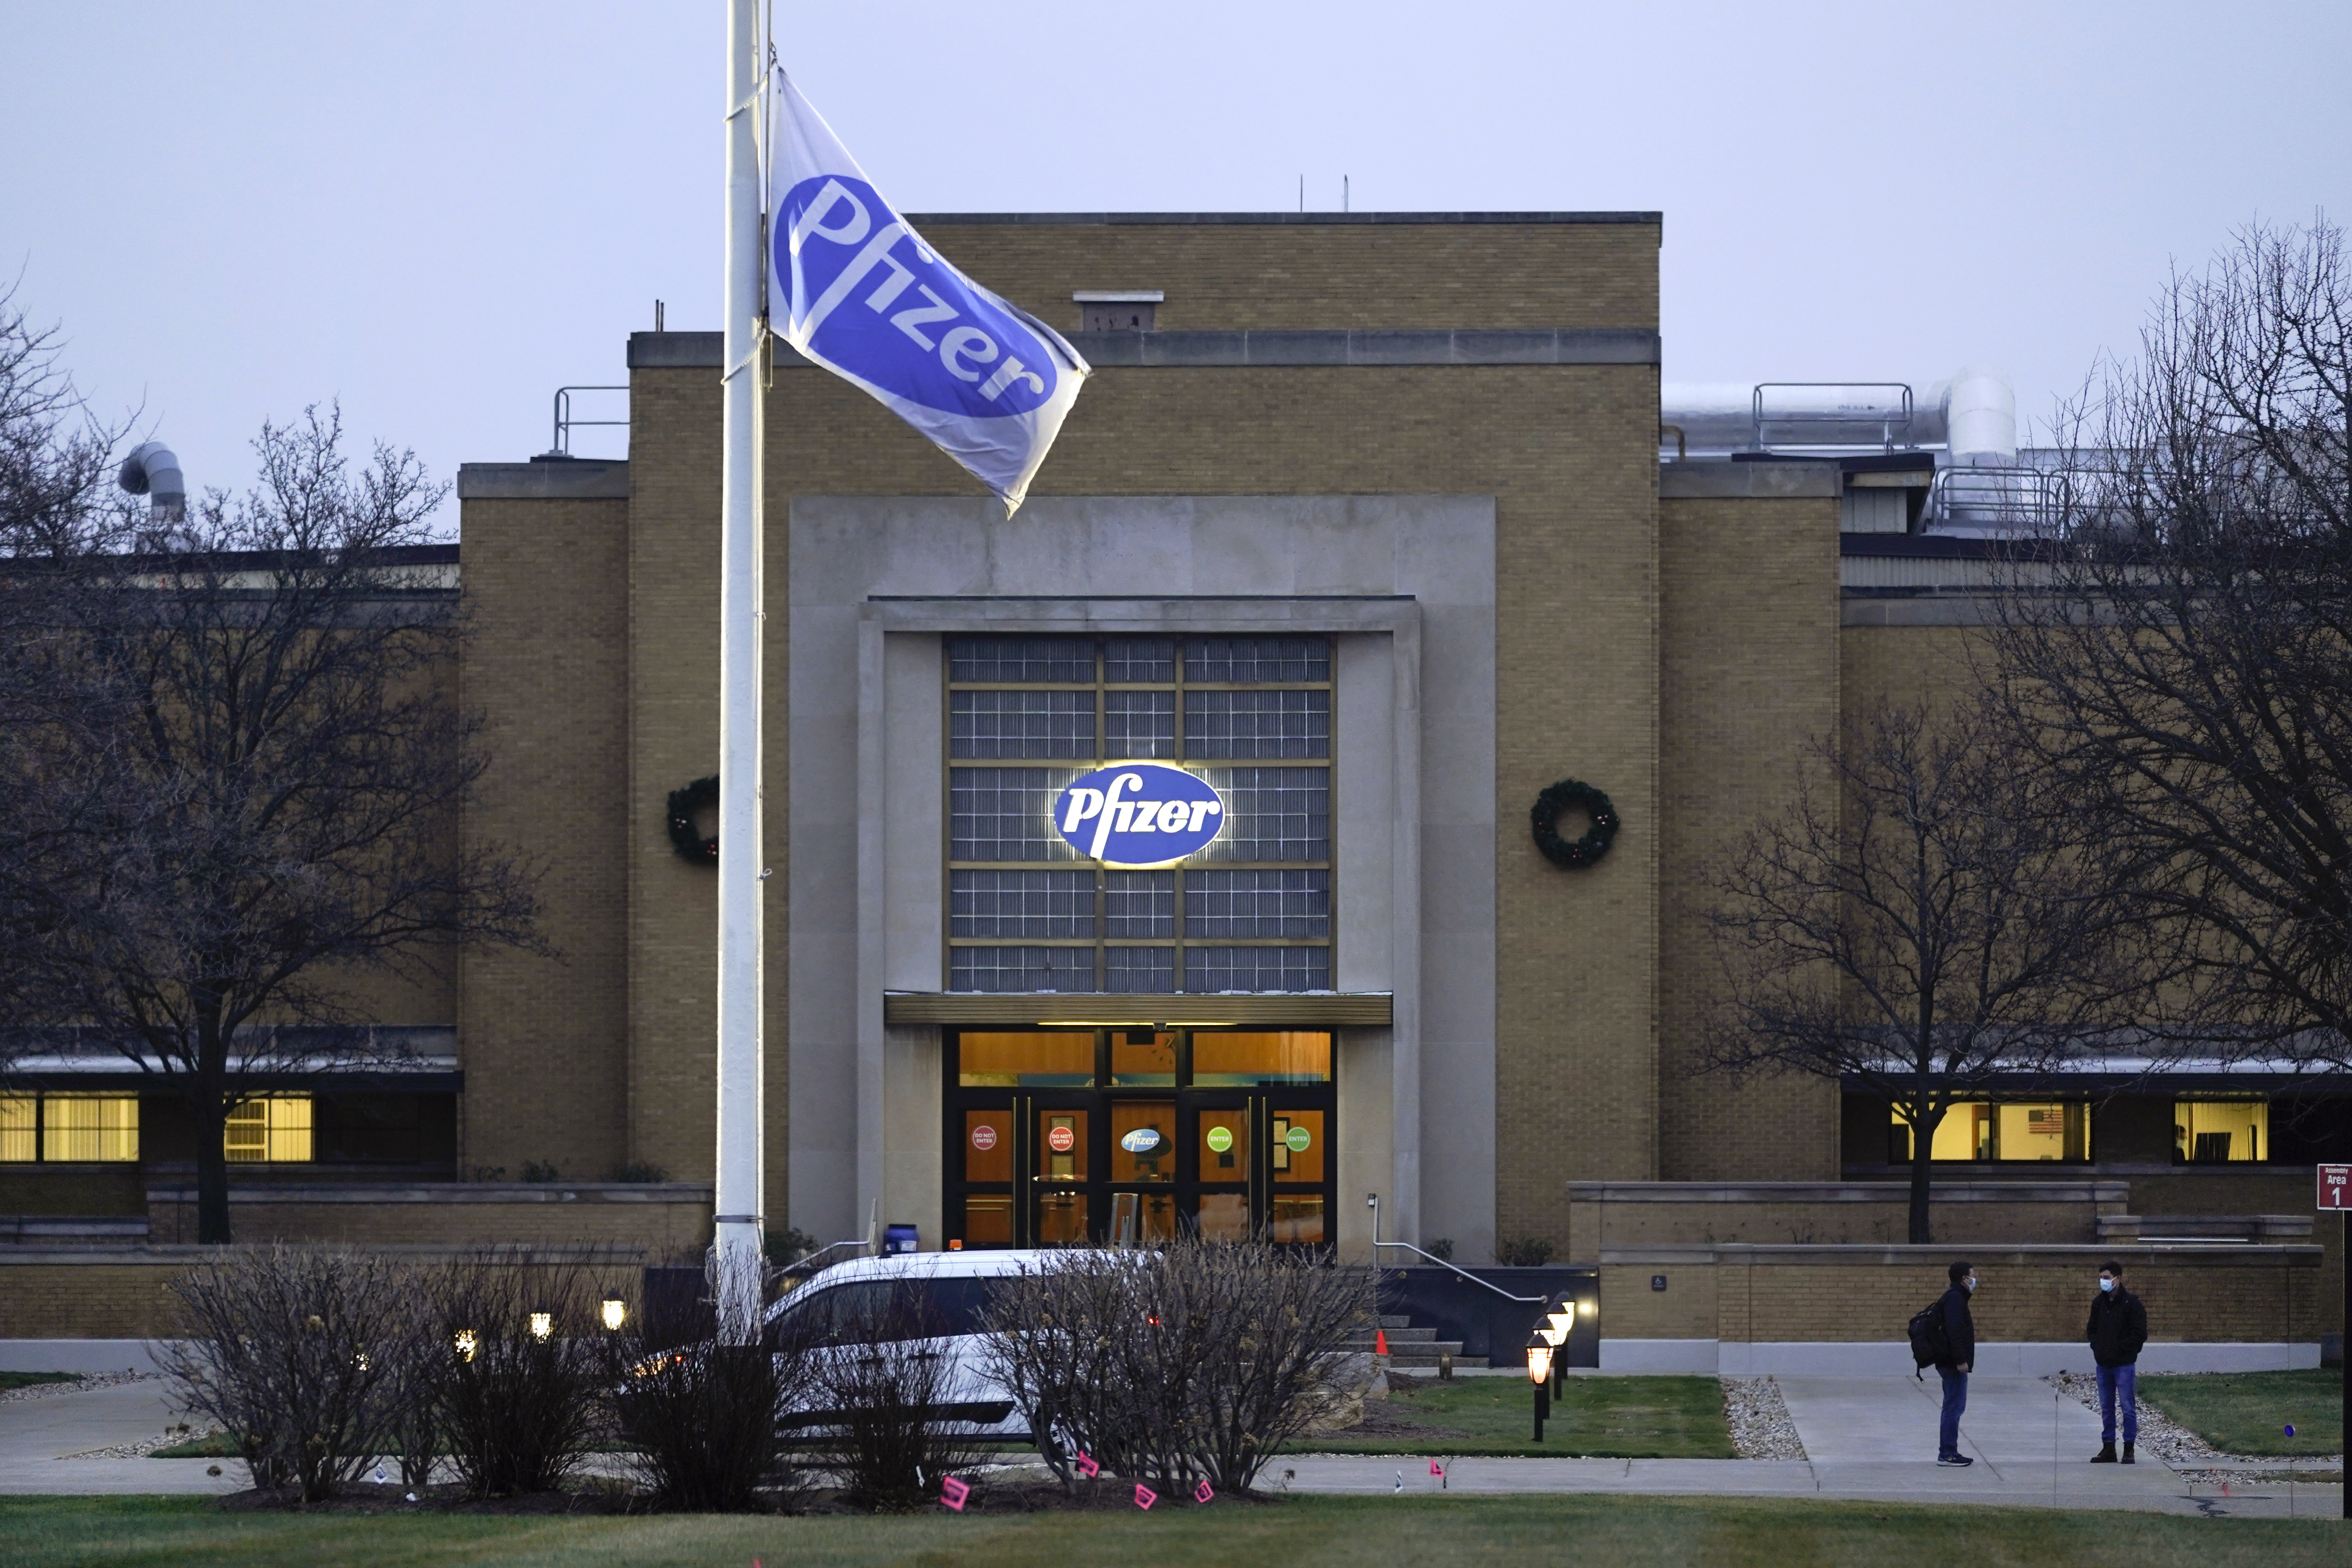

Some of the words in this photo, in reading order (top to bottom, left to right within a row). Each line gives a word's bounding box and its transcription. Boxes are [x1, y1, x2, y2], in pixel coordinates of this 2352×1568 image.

[790, 178, 1044, 402] Pfizer
[1063, 773, 1221, 859] Pfizer
[1125, 1133, 1159, 1151] Pfizer
[2327, 1175, 2346, 1184] Area
[2332, 1187, 2340, 1206] 1
